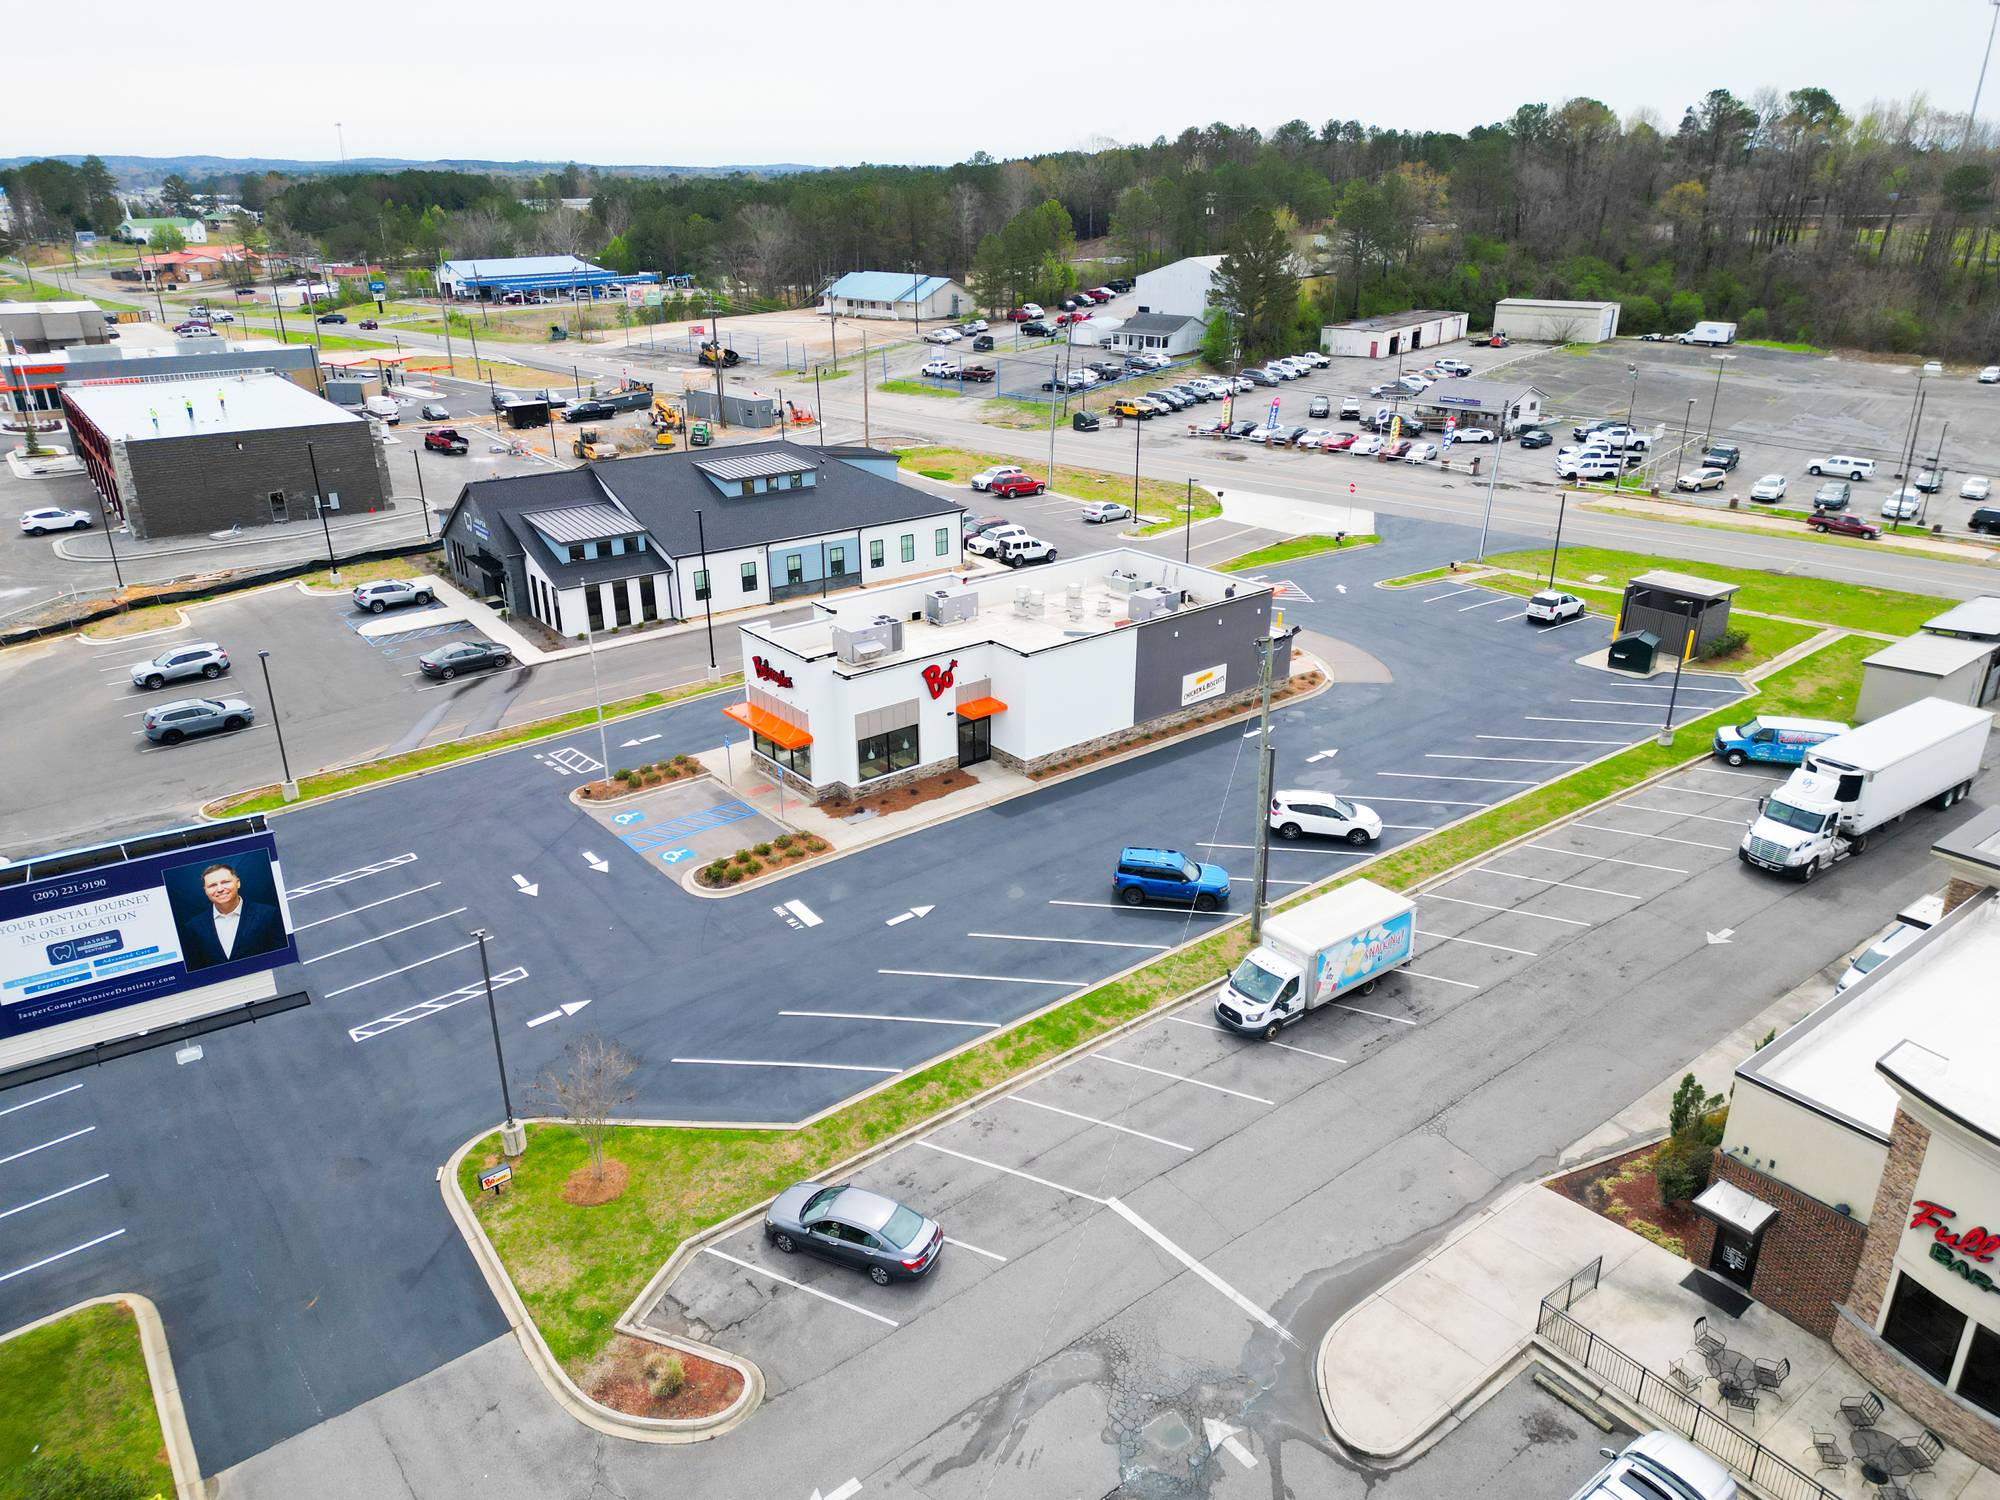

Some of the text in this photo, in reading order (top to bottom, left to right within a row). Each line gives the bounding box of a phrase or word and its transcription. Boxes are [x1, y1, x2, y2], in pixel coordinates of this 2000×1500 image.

[32, 879, 107, 902] (205) 221-9190
[0, 893, 151, 936] YOUR DENTAL JOURNEY
[21, 910, 137, 944] IN ONE LOCATION
[18, 975, 176, 1020] JasperComprehensiveDentistry.com
[1909, 1200, 2000, 1263] Full
